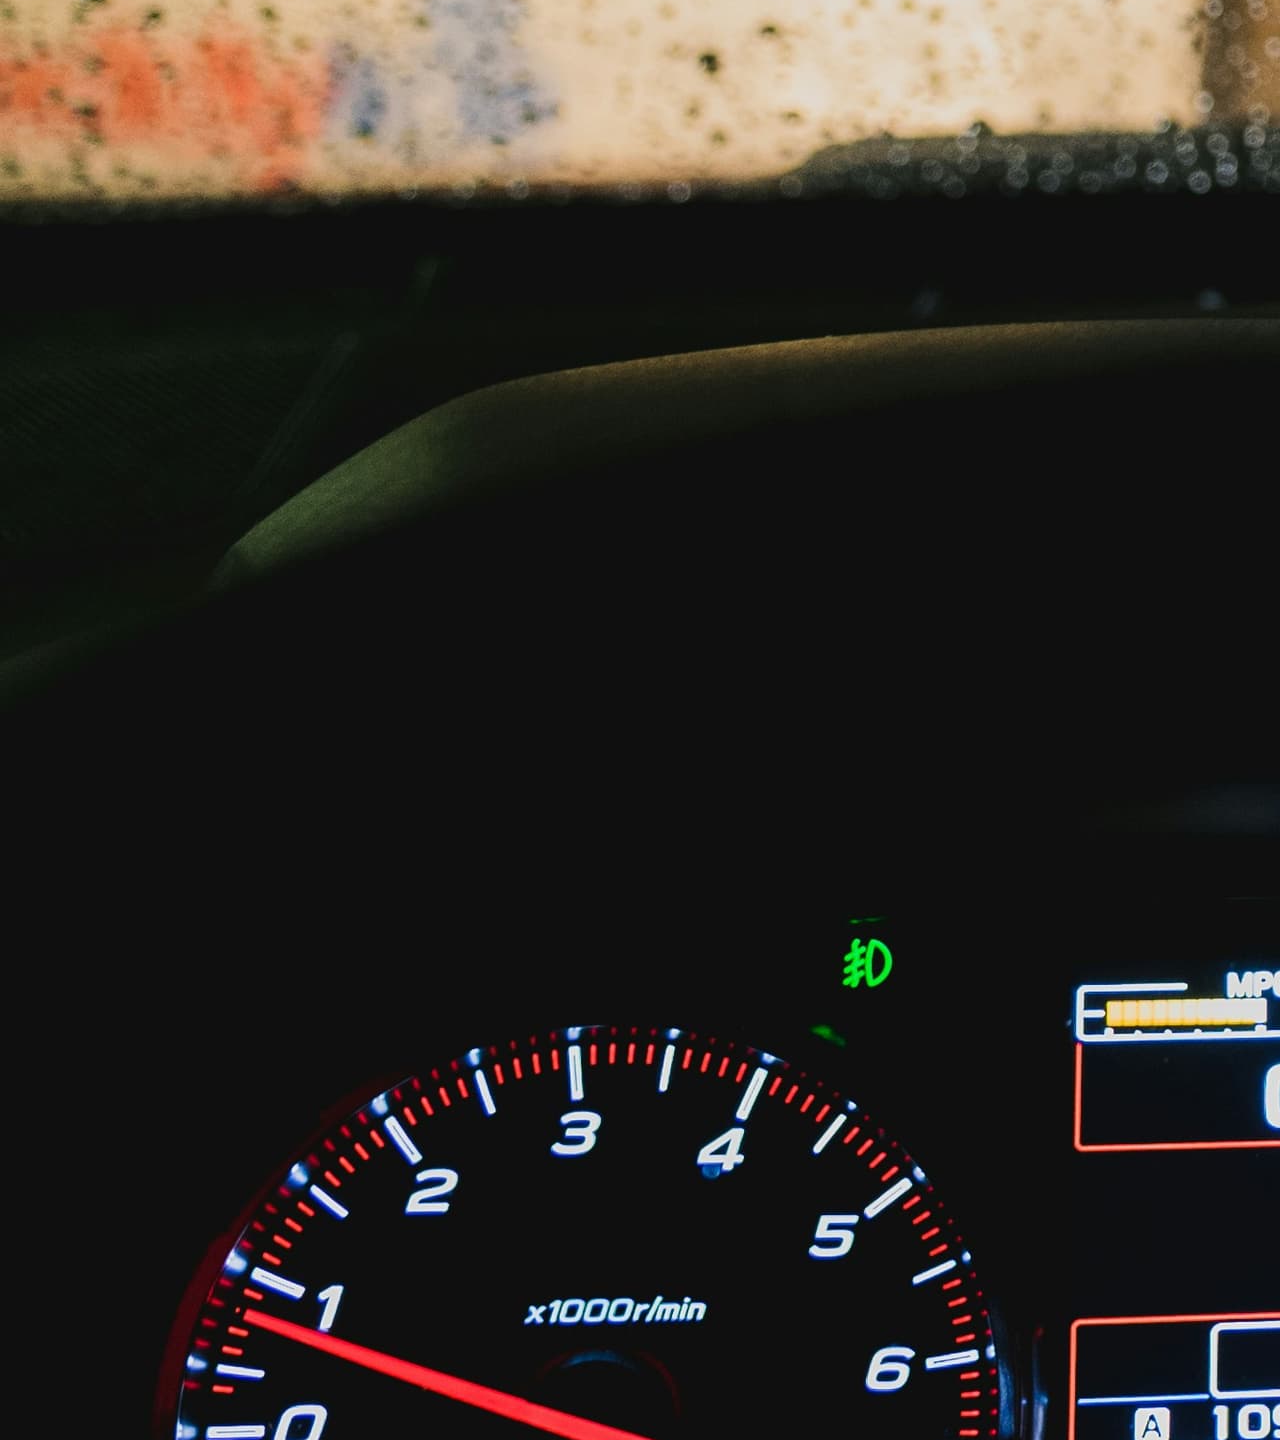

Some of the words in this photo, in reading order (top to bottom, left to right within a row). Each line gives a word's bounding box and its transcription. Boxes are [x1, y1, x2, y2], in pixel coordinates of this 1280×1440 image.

[551, 1111, 601, 1155] 3
[697, 1128, 744, 1173] 4
[406, 1169, 458, 1213] 2
[809, 1215, 859, 1257] 5
[318, 1285, 344, 1331] 1
[866, 1347, 915, 1391] 6
[1138, 1410, 1166, 1440] A
